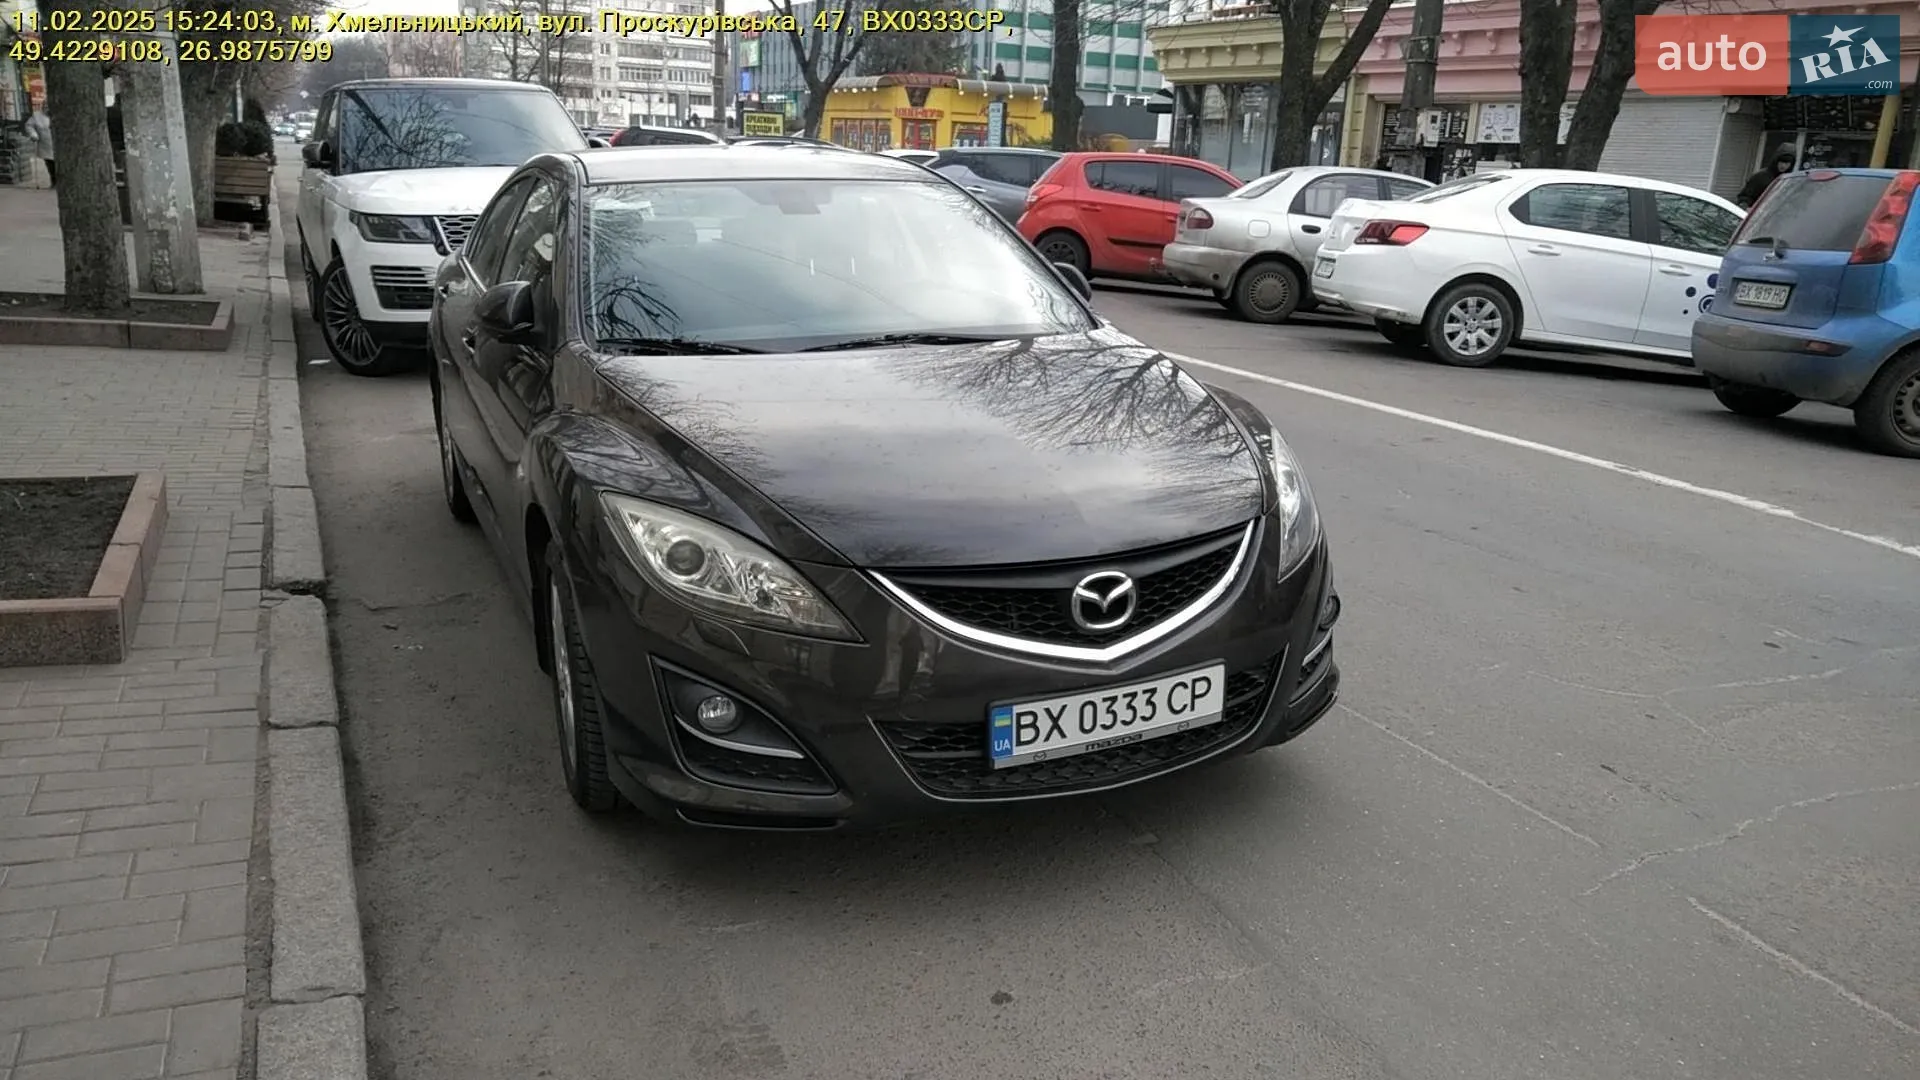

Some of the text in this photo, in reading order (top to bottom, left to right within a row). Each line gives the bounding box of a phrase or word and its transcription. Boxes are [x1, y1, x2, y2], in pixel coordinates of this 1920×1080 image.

[1016, 676, 1212, 746] BX 0333 CP
[994, 740, 1011, 752] UA
[1085, 733, 1143, 751] mazda
